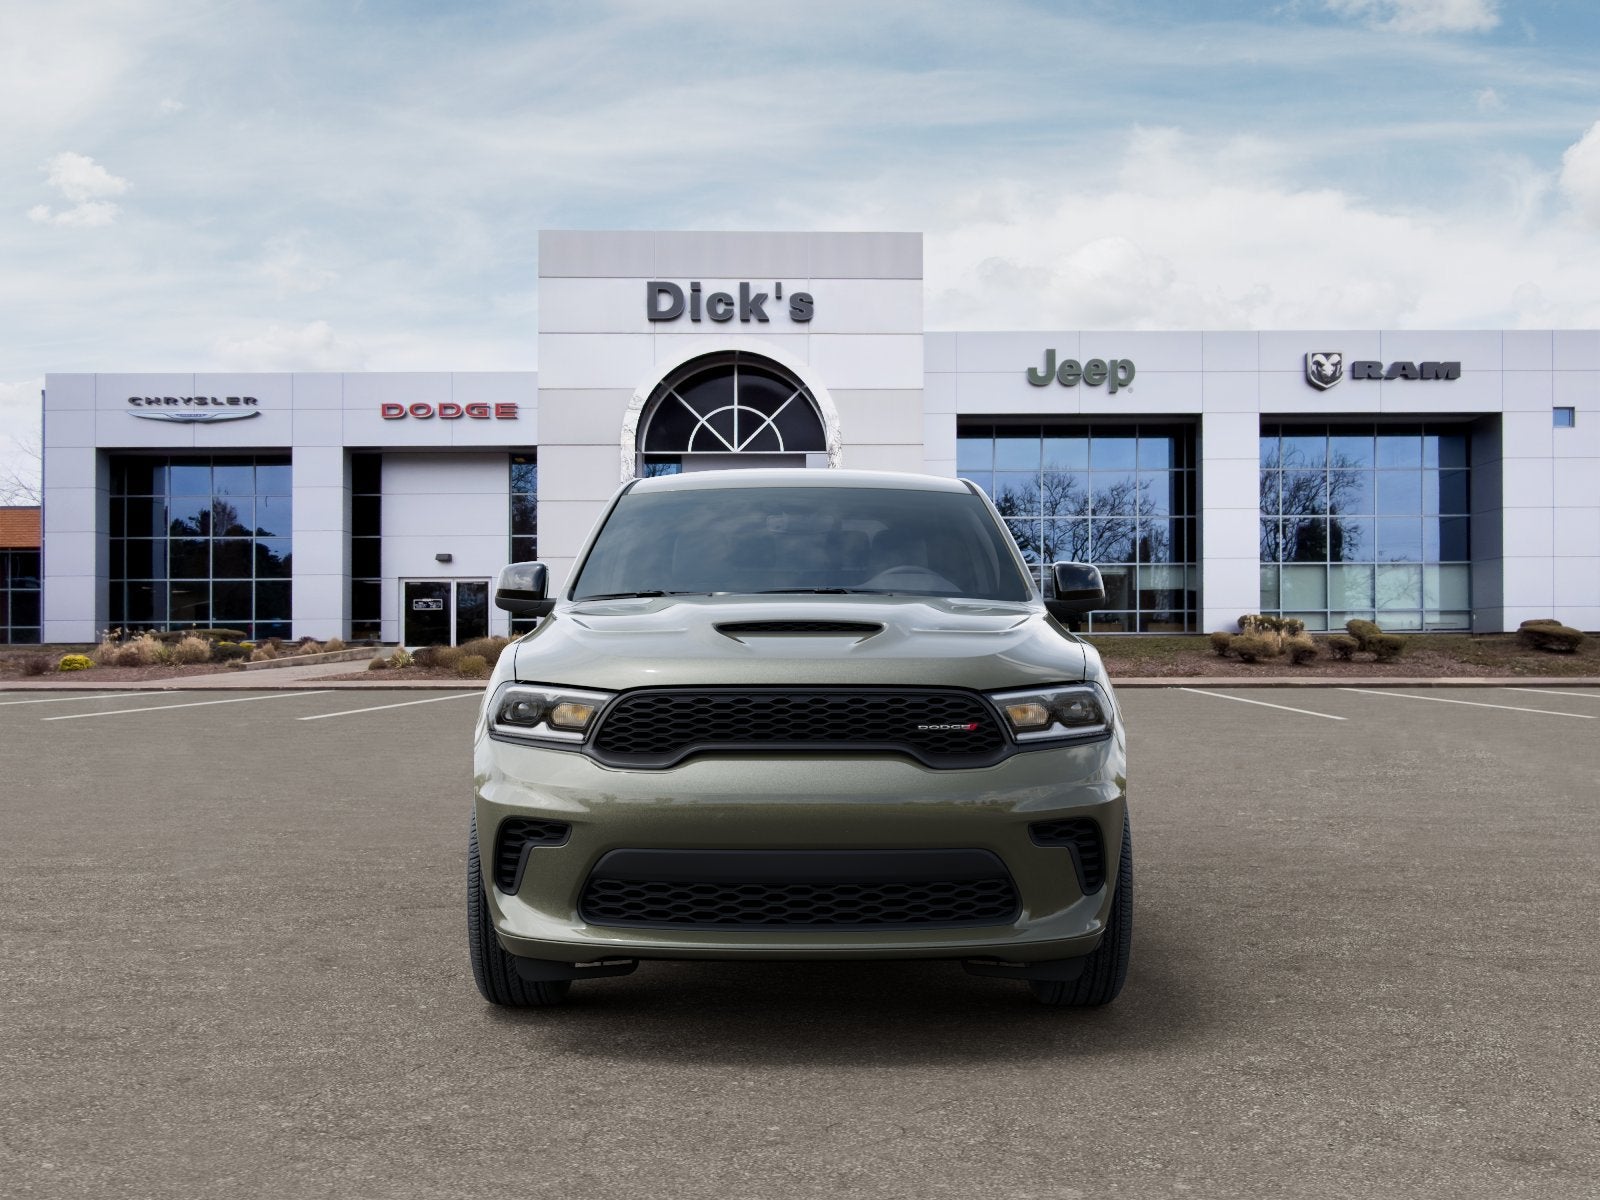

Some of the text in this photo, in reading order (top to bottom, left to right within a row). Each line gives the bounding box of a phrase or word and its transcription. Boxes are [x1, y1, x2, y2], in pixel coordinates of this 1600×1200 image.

[647, 281, 814, 322] Dick's
[1027, 348, 1136, 393] Jeep
[1351, 360, 1461, 381] RAM
[128, 396, 259, 407] CHRYSLER
[381, 402, 520, 420] DODGE
